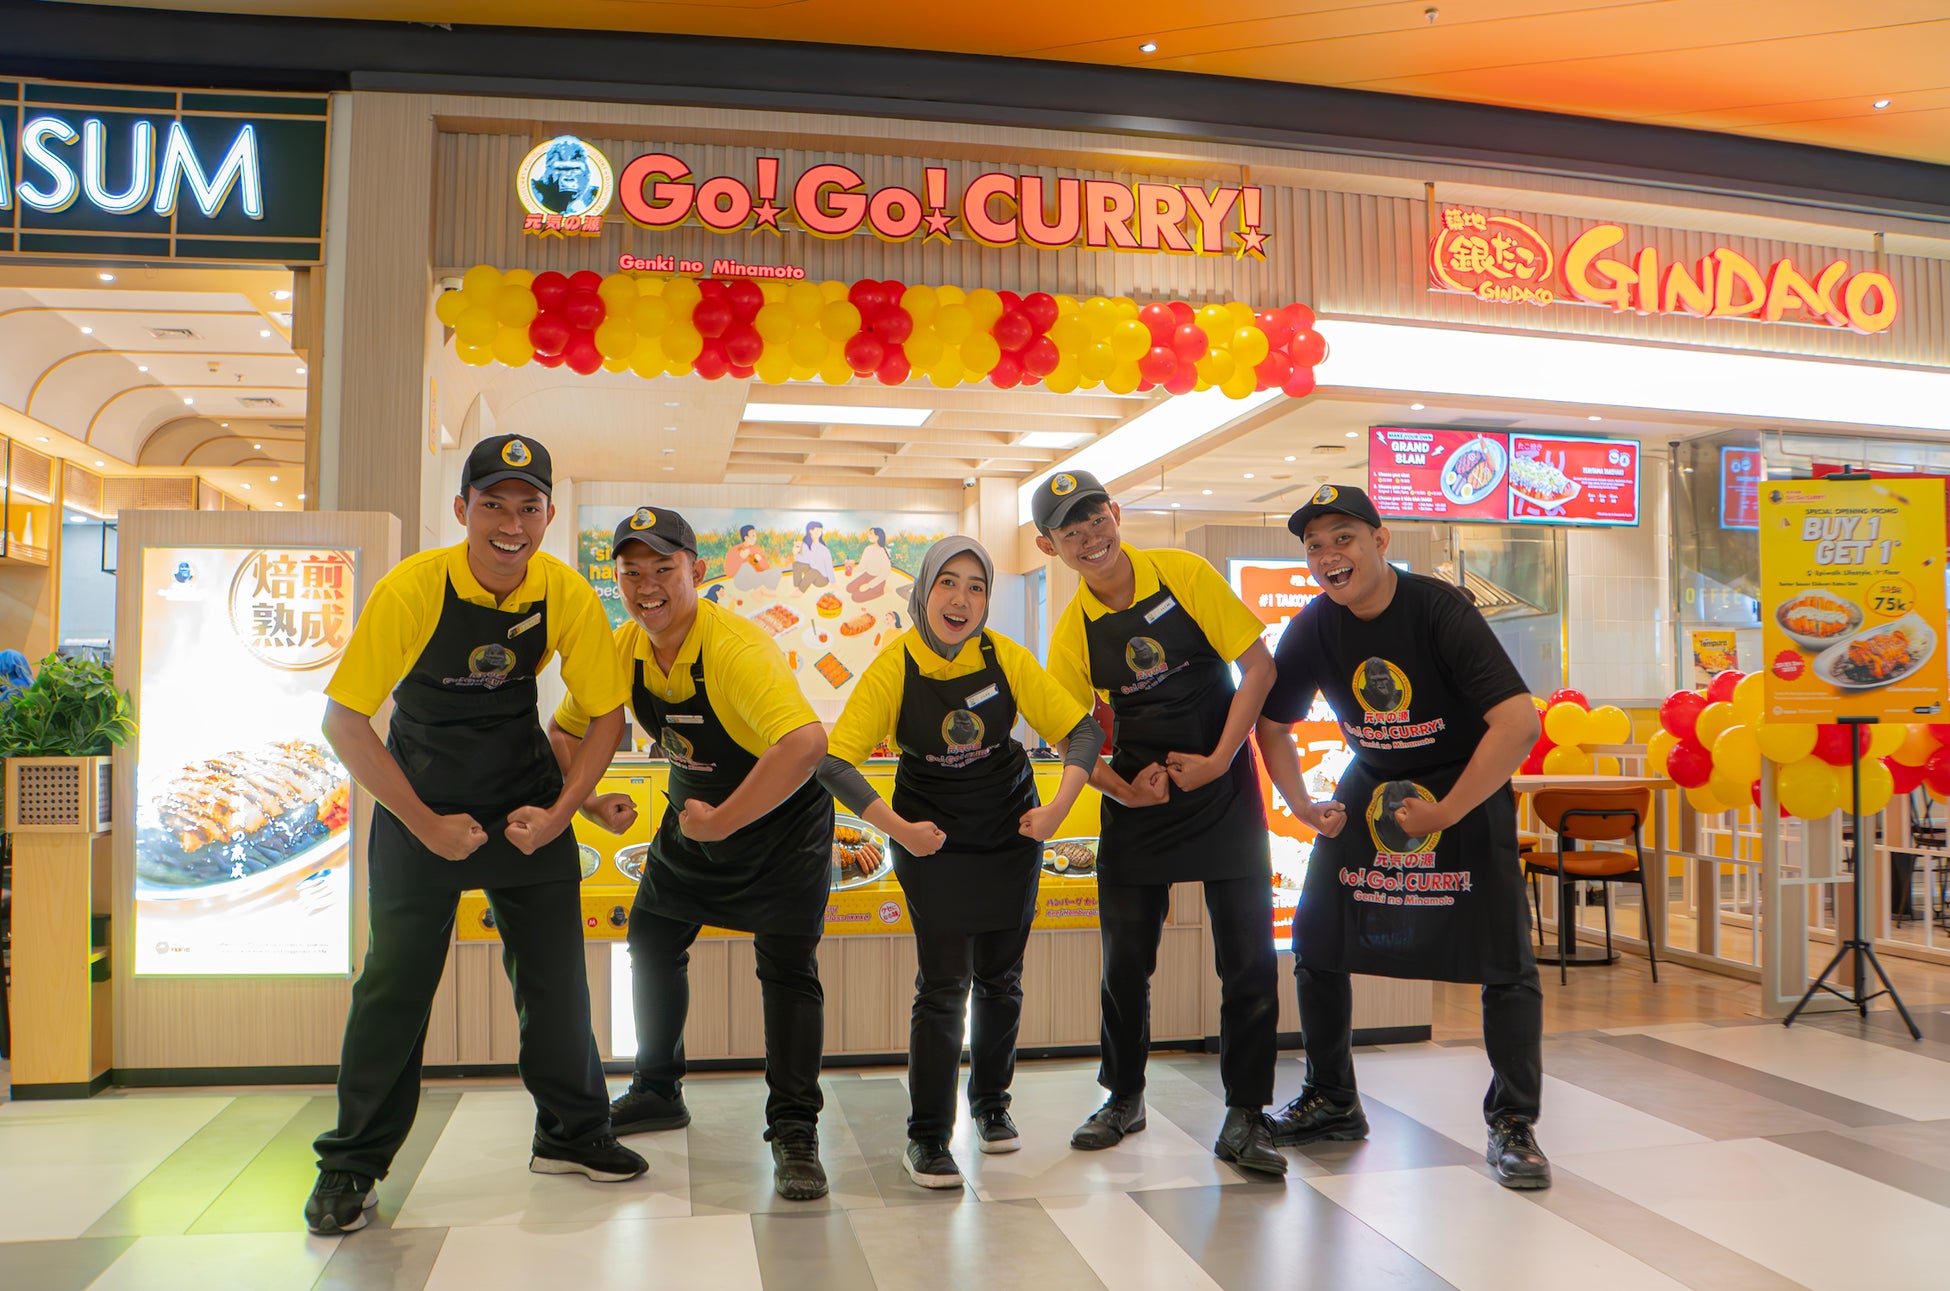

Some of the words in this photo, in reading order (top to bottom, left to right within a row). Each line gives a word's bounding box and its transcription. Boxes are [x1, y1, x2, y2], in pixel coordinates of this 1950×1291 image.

[0, 115, 264, 220] SUM
[619, 152, 788, 237] Go!
[794, 162, 958, 245] Go!
[962, 171, 1272, 261] CURRY!
[523, 213, 602, 236] 元気の源
[1448, 231, 1537, 280] 銀だこ
[619, 254, 675, 276] Genki
[679, 258, 704, 273] no
[712, 259, 806, 281] Minamoto
[1560, 223, 1899, 333] GINDACO
[1479, 280, 1554, 305] GINDACO
[1391, 441, 1430, 453] GRAND
[1395, 454, 1426, 465] SLAM
[1802, 516, 1862, 541] BUY
[1868, 516, 1881, 541] 1
[595, 544, 613, 562] si
[1815, 540, 1872, 565] GET
[1875, 597, 1908, 611] 75k
[252, 603, 345, 648] 熟成
[1700, 638, 1728, 648] Tempura
[1364, 710, 1410, 725] 元気の源
[1363, 724, 1390, 740] Go!
[1389, 718, 1446, 740] CURRY!
[1393, 737, 1436, 749] Minamoto
[1374, 851, 1436, 869] 元気の源
[1367, 871, 1405, 892] Go!
[1405, 871, 1473, 893] CURRY!
[1353, 890, 1387, 904] Genki
[1387, 896, 1403, 905] no
[1404, 895, 1455, 905] Minamoto
